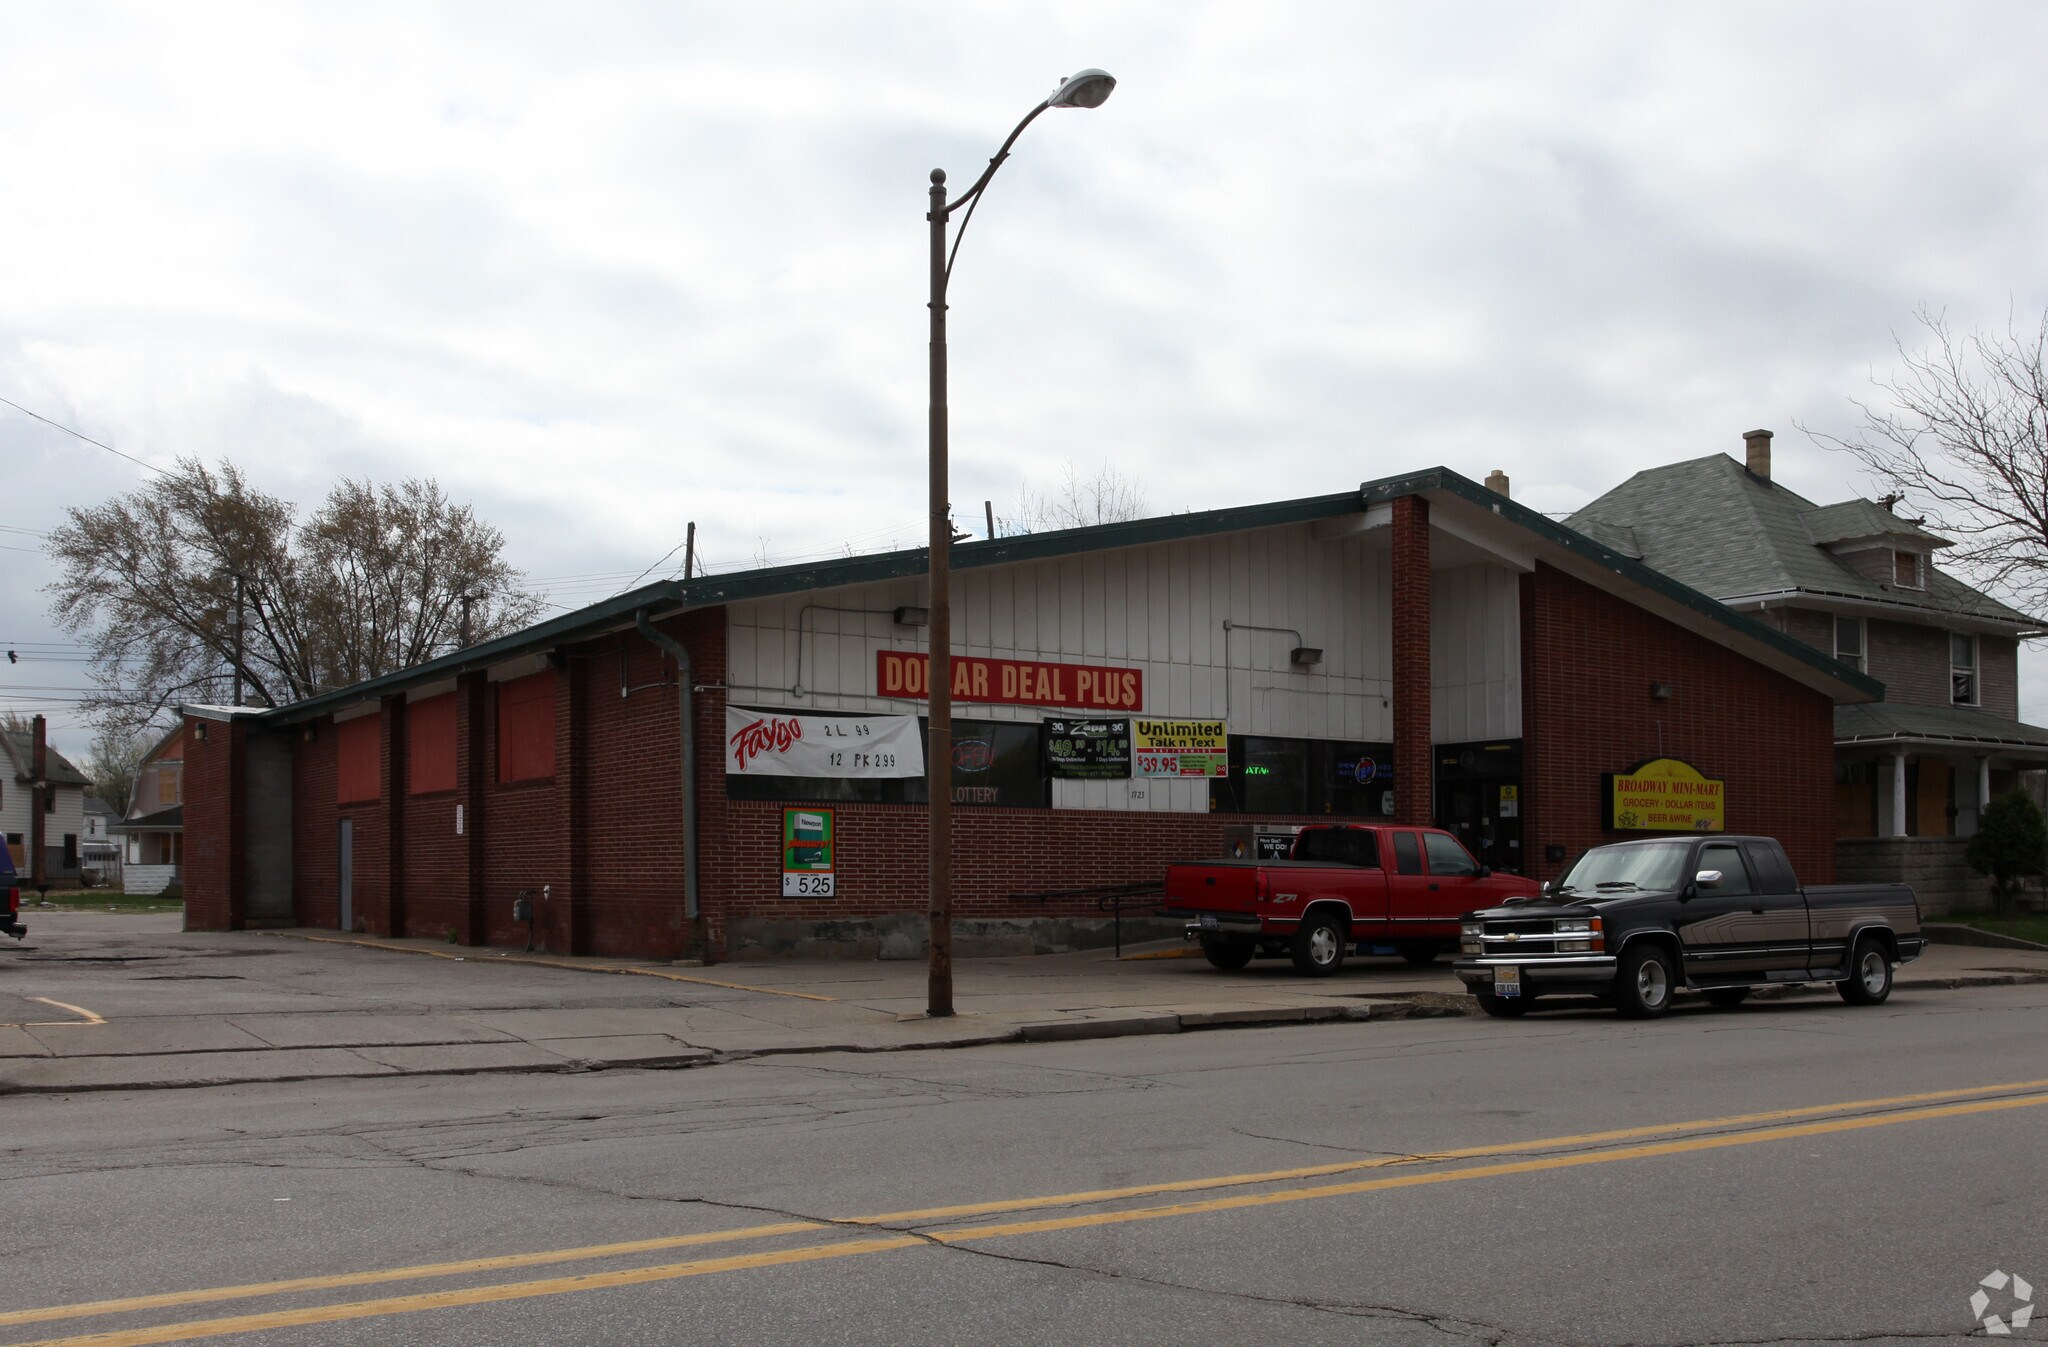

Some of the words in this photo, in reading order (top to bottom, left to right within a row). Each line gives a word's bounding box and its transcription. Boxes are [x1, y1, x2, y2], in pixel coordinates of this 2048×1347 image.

[885, 656, 989, 698] DOLAR
[1002, 664, 1066, 702] DEAL
[824, 725, 832, 737] 2
[836, 725, 848, 737] L
[855, 725, 870, 737] 99
[1051, 722, 1064, 732] 3G
[1111, 723, 1124, 732] 3G
[1138, 721, 1223, 737] Unlimited
[729, 717, 803, 771] Faygo
[1148, 737, 1176, 748] Talk
[1179, 739, 1187, 748] n
[1189, 737, 1216, 748] Text
[830, 753, 842, 767] 12
[854, 753, 870, 769] PK
[874, 753, 896, 768] 2.99
[951, 746, 995, 766] OPEN
[1138, 755, 1178, 773] $39.95
[951, 786, 999, 803] LOTTERY
[1617, 779, 1668, 794] BROADWAY
[1671, 782, 1721, 797] MINI-MART
[1622, 798, 1660, 808] GROCERY
[1665, 799, 1694, 810] DOLLAR
[1695, 801, 1716, 810] ITEMS
[801, 819, 822, 828] Newport
[1648, 813, 1669, 823] BEER
[1263, 843, 1274, 851] WE
[799, 877, 831, 896] 5.25
